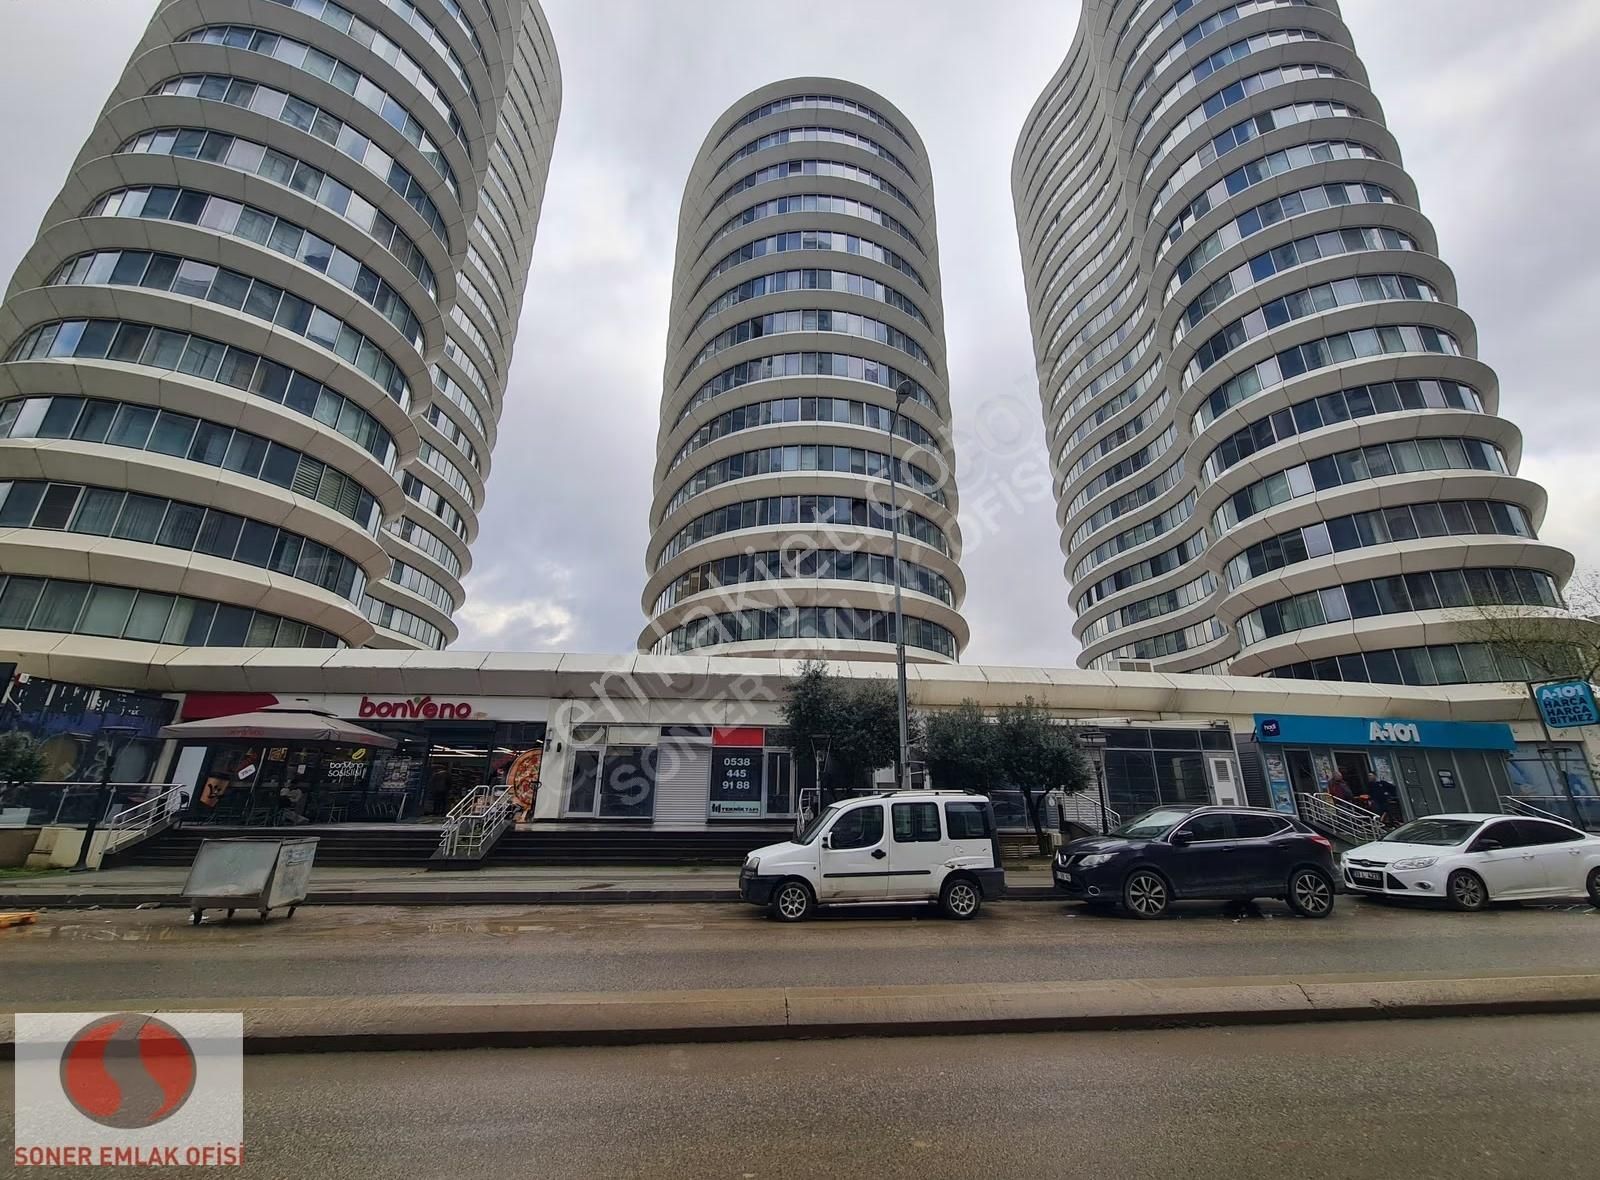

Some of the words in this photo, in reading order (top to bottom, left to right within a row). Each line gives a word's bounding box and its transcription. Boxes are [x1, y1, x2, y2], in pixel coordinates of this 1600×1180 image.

[1543, 696, 1588, 709] HARCA
[1547, 704, 1591, 717] HARCA
[723, 757, 751, 766] 0538
[726, 769, 747, 778] 445
[722, 780, 734, 790] 91
[736, 780, 750, 790] 88
